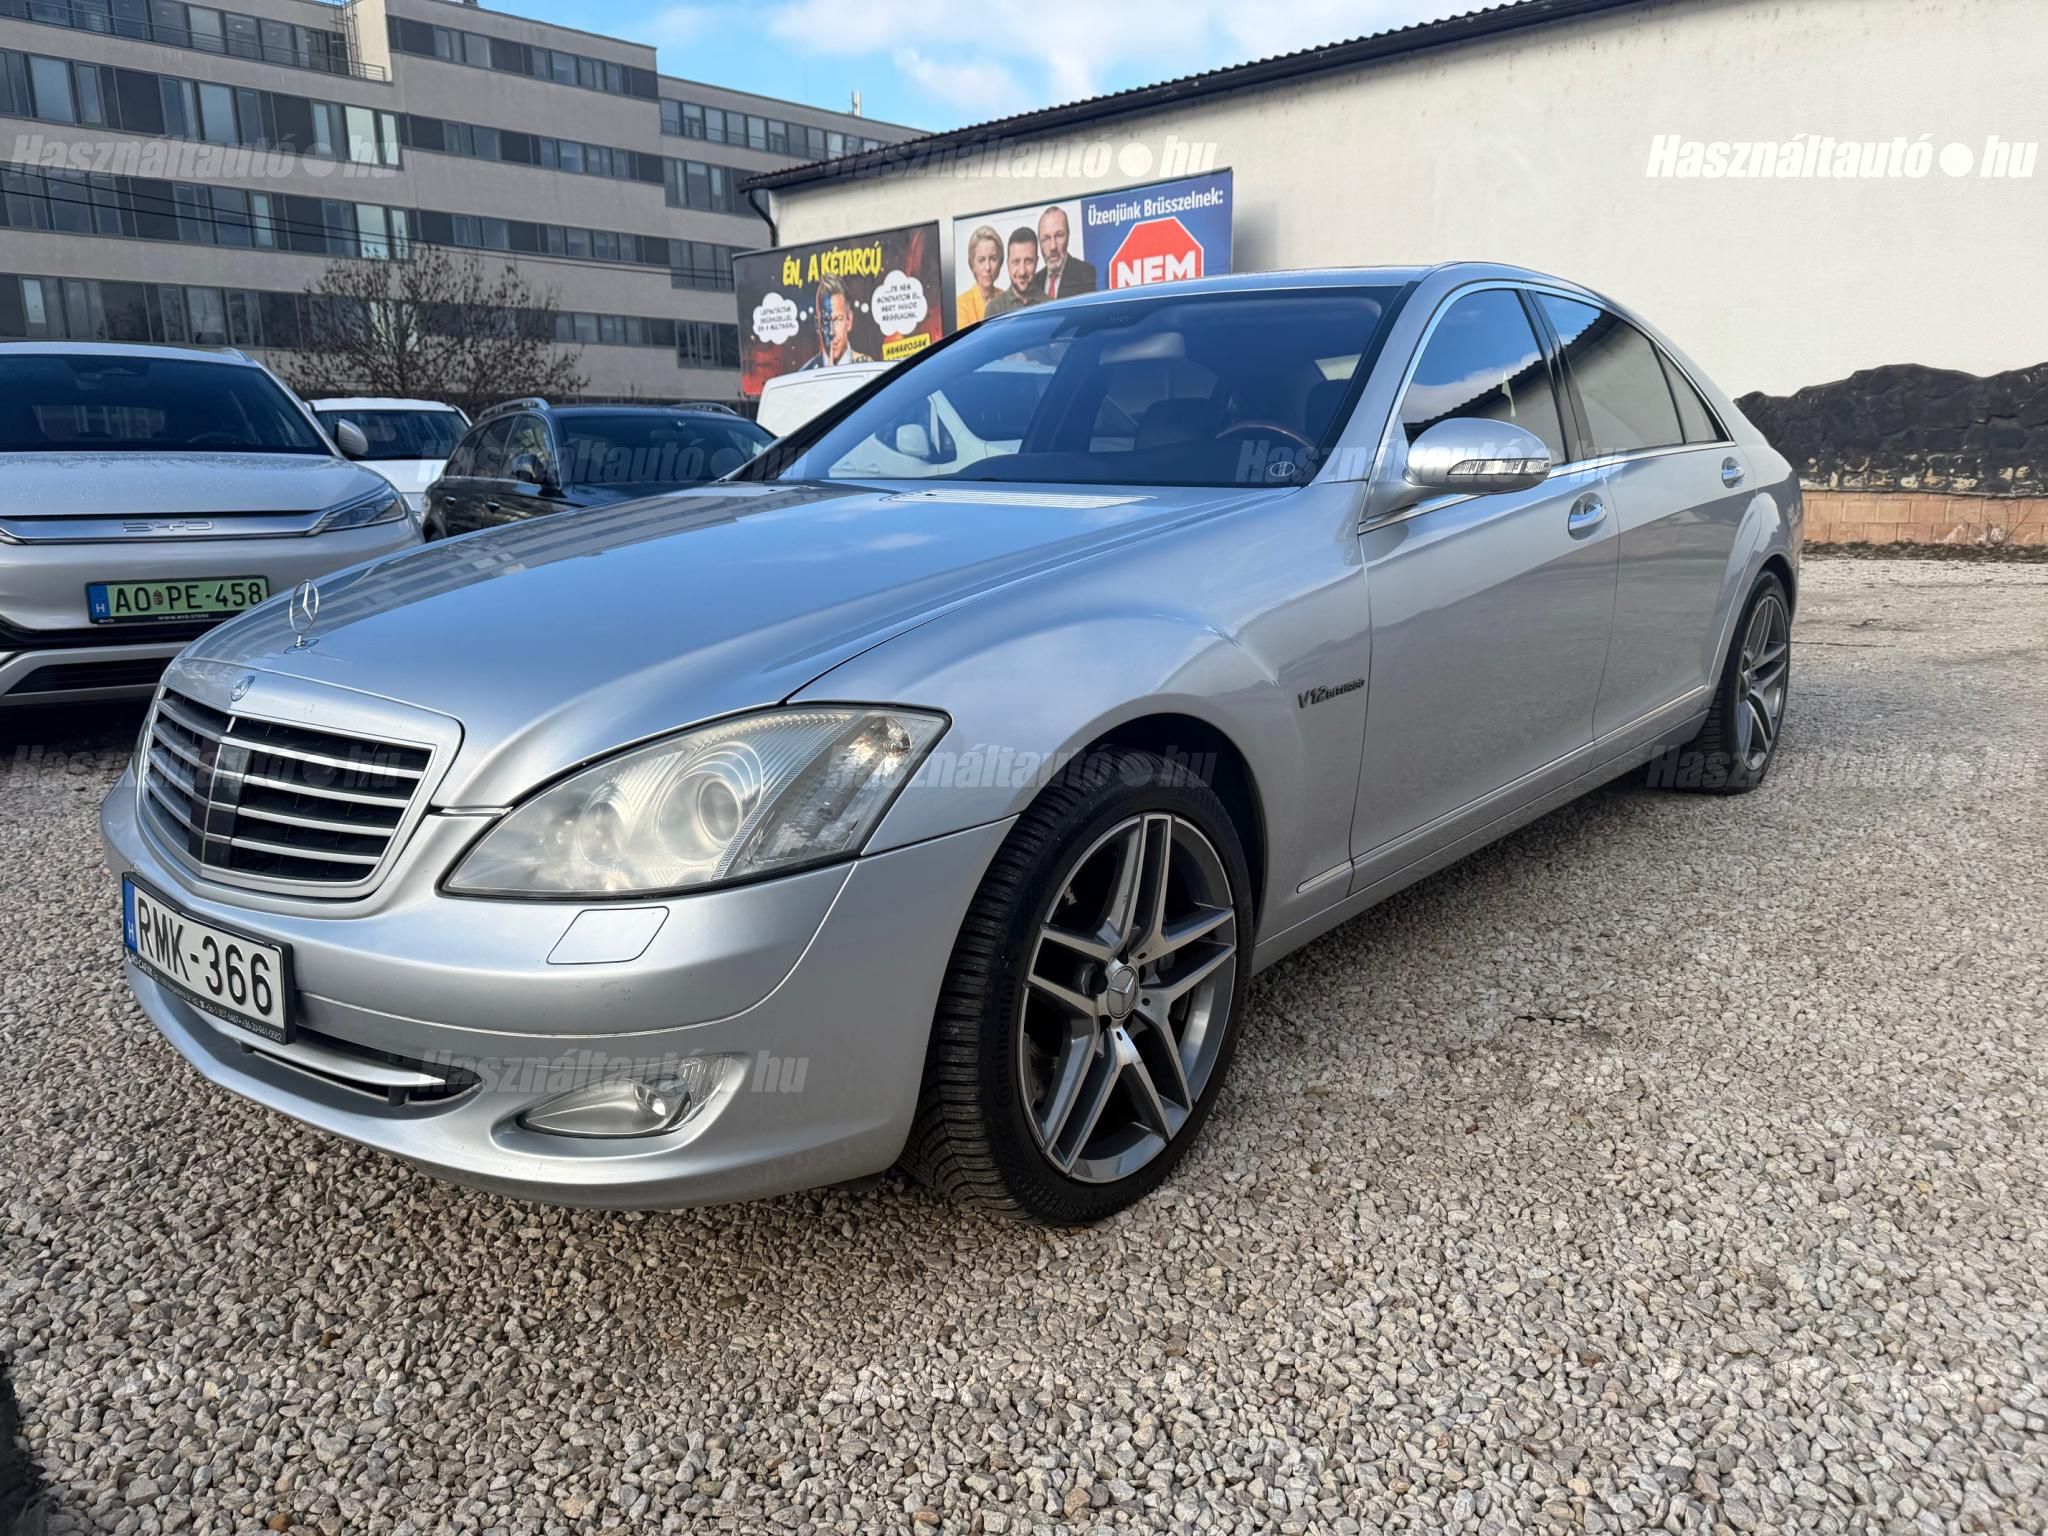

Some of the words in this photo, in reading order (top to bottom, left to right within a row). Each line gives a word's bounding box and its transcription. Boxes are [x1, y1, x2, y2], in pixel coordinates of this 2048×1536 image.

[1088, 201, 1141, 226] Üzenjünk
[1143, 187, 1224, 217] Brüsszelnek:
[782, 255, 803, 288] ÉN,
[807, 253, 820, 283] A
[820, 240, 882, 278] KÉTARCÚ
[1117, 250, 1196, 289] NEM
[122, 519, 213, 533] BYD
[138, 896, 273, 1016] RMK-366
